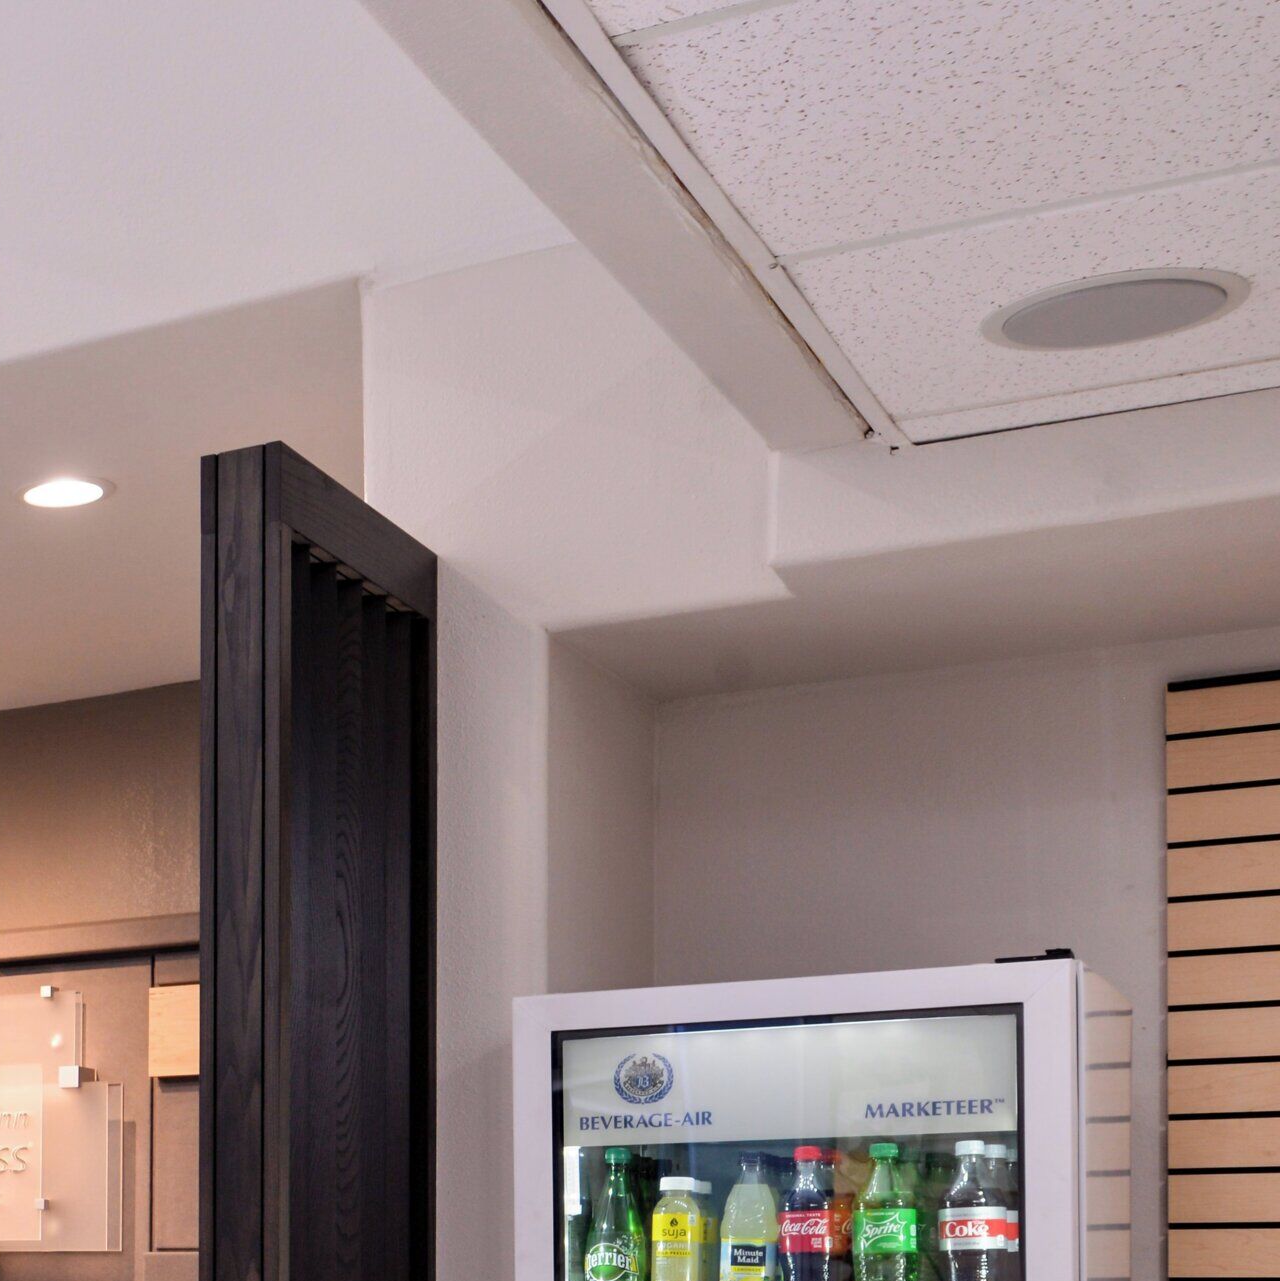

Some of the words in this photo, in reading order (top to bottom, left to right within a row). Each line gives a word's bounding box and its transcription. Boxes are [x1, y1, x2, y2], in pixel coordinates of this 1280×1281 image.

[579, 1111, 713, 1131] BEVERAGE-AIR
[662, 1228, 687, 1240] suja
[781, 1218, 829, 1237] Coca-Cola
[863, 1222, 901, 1238] Sprite
[945, 1220, 990, 1238] Coke
[733, 1248, 764, 1257] Minute
[737, 1256, 760, 1264] Maid
